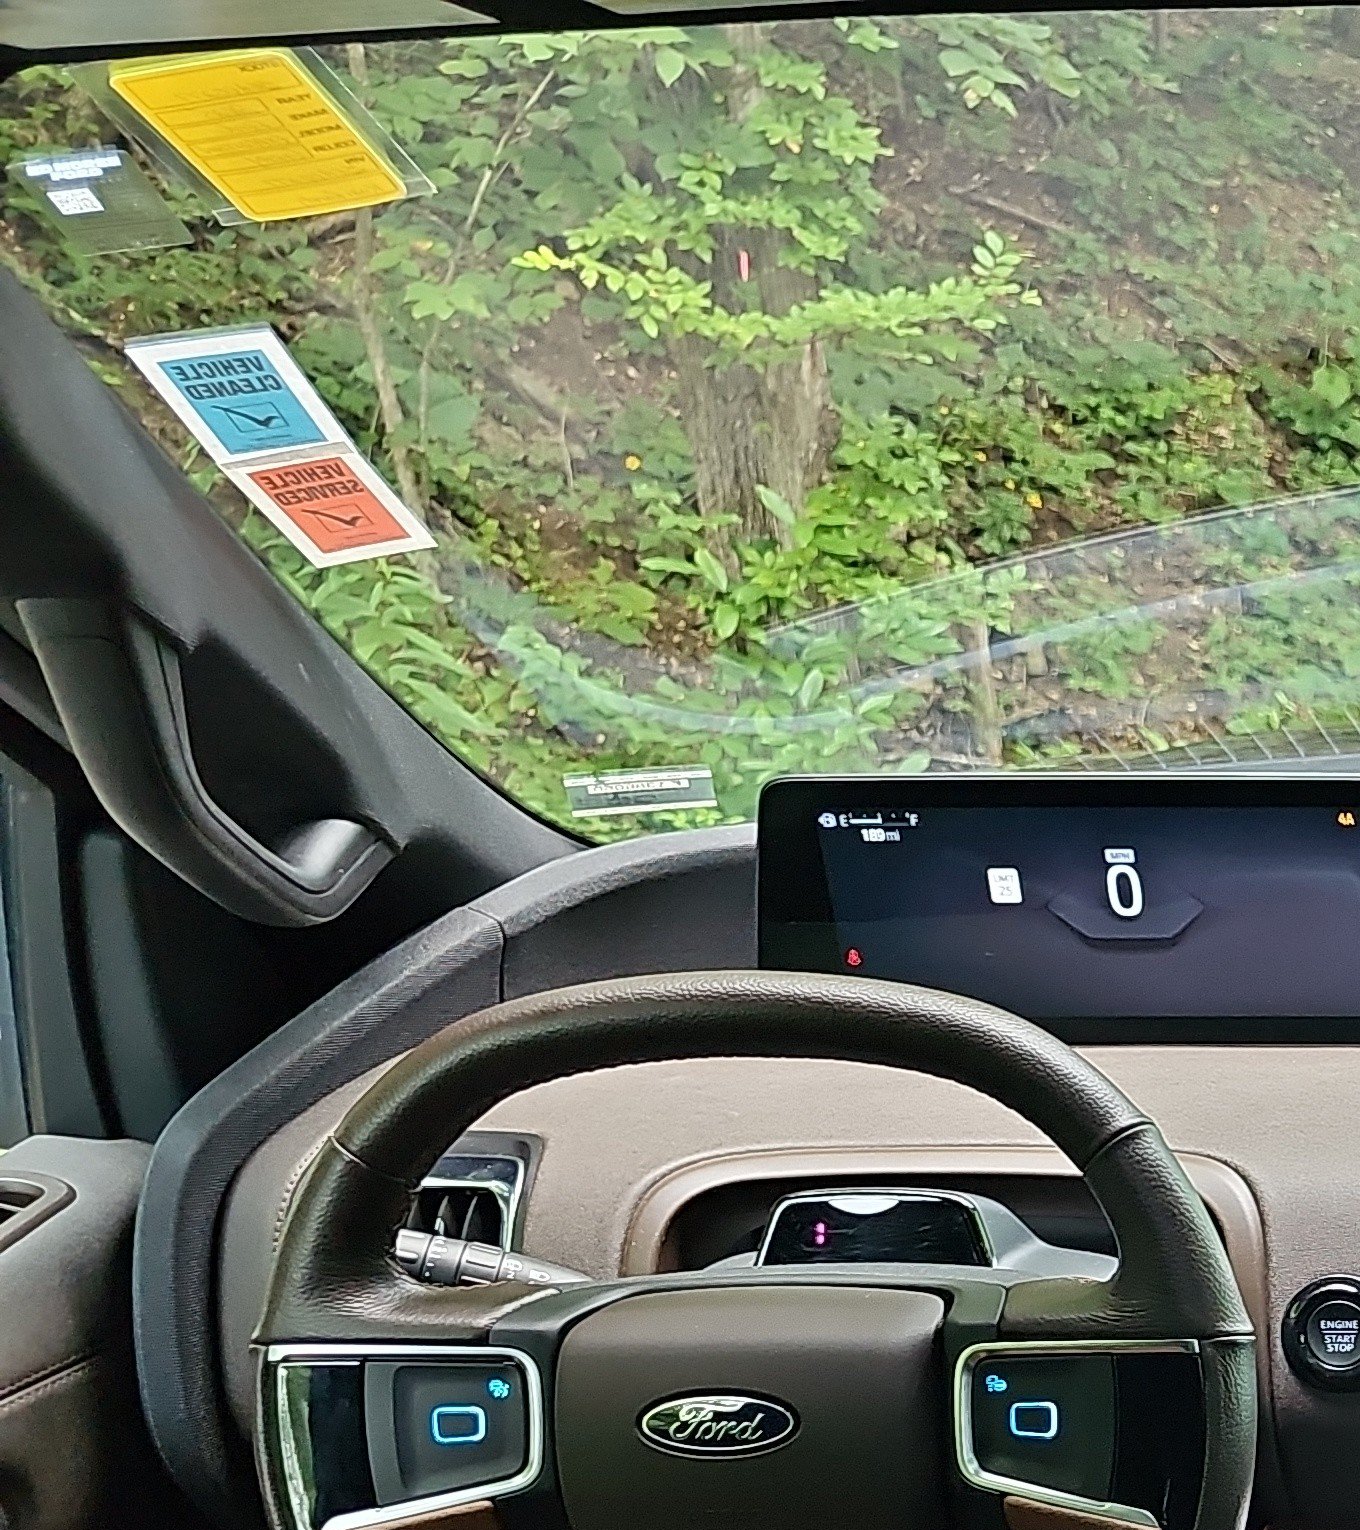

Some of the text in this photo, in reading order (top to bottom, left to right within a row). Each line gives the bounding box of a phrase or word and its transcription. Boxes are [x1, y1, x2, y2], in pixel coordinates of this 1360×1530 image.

[1106, 864, 1144, 917] 0
[1320, 1320, 1359, 1329] ENGINE
[1324, 1335, 1356, 1343] START
[1326, 1343, 1354, 1352] STOP
[669, 1399, 767, 1441] Ford
